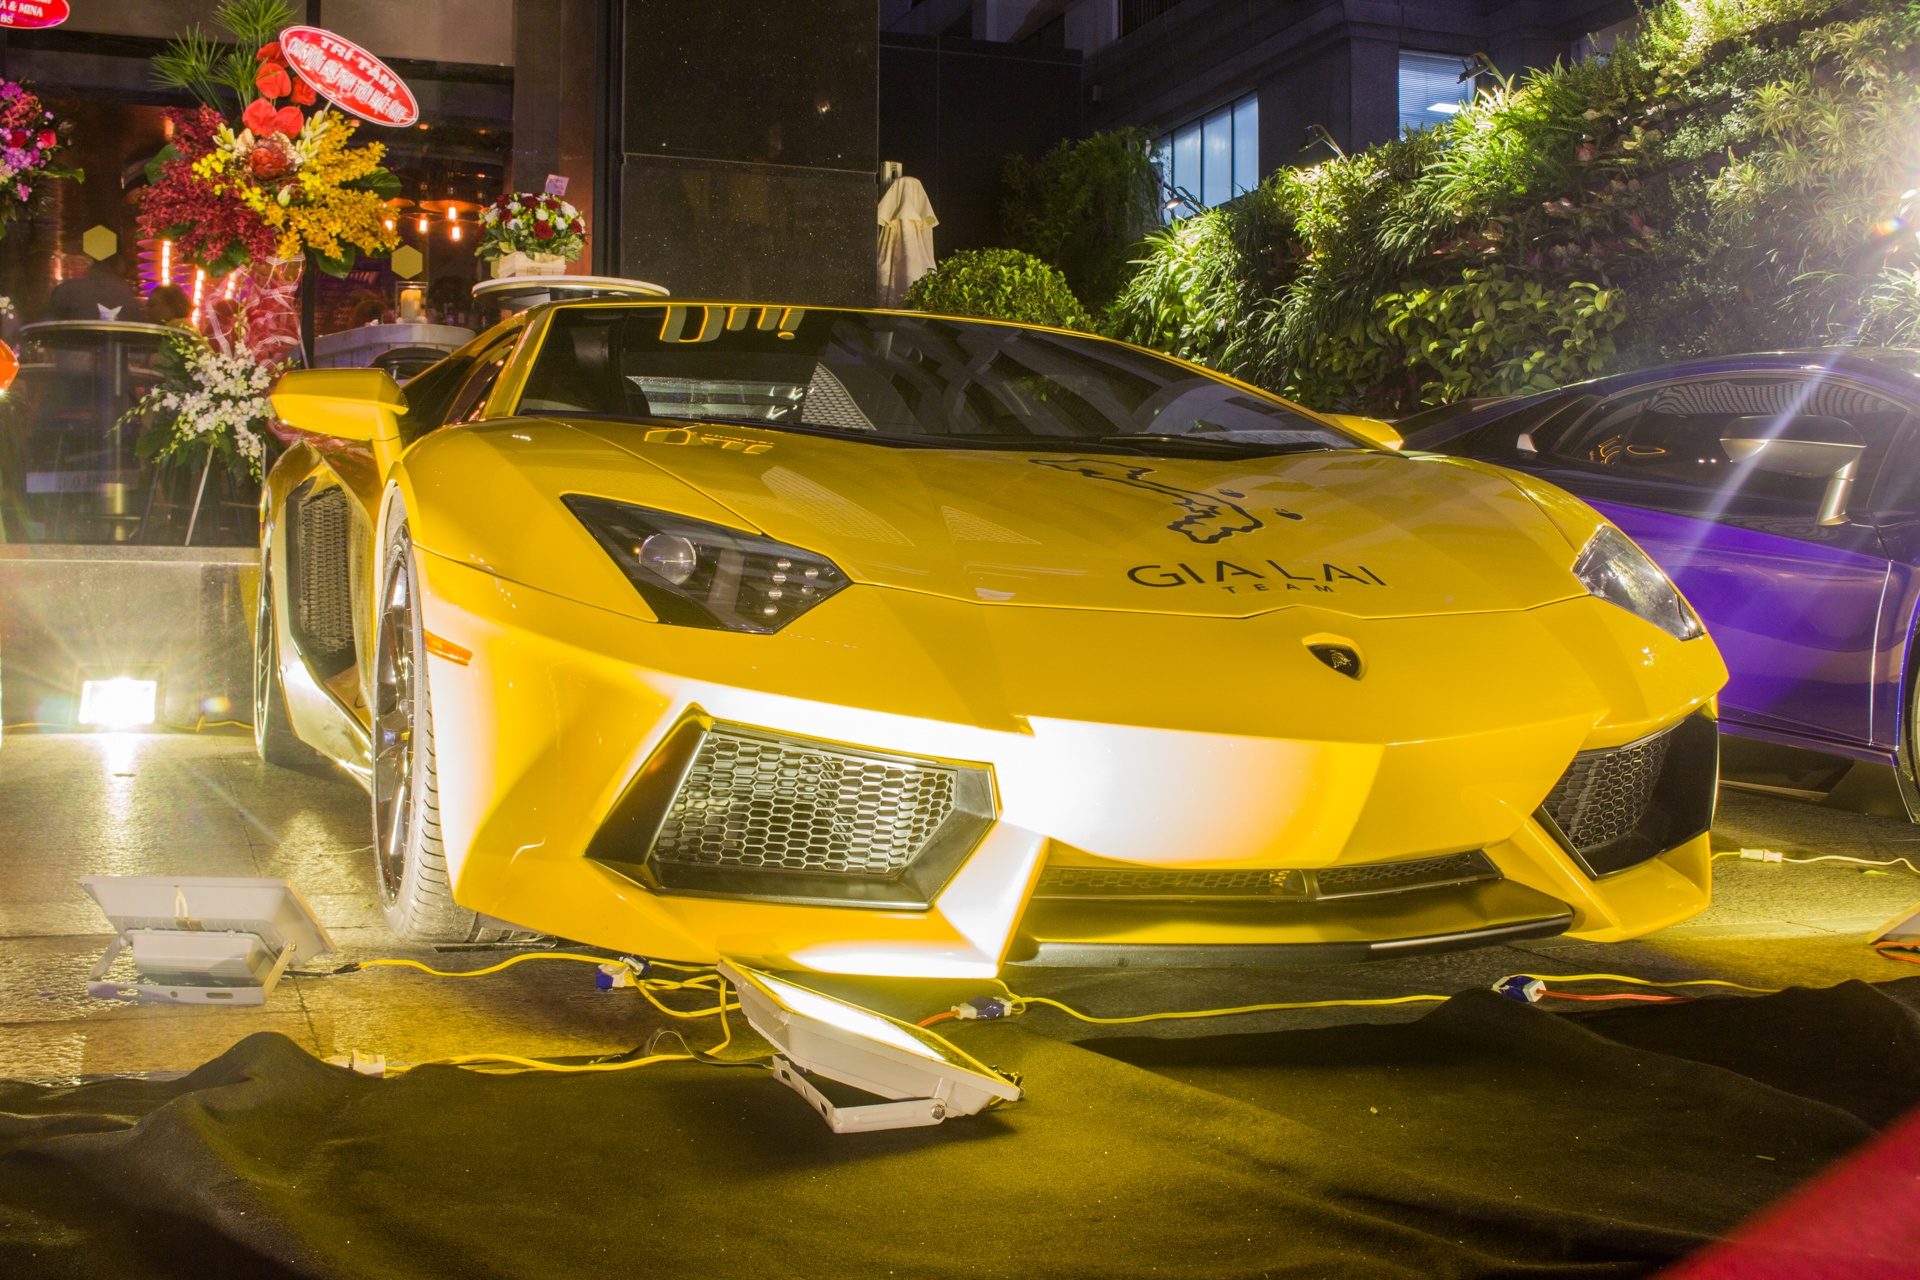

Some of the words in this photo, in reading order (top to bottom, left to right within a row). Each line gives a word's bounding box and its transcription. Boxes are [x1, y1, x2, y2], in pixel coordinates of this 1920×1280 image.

[8, 1, 17, 11] &
[18, 3, 43, 17] MINA
[358, 56, 397, 93] TÂM
[1222, 584, 1334, 594] TEAM
